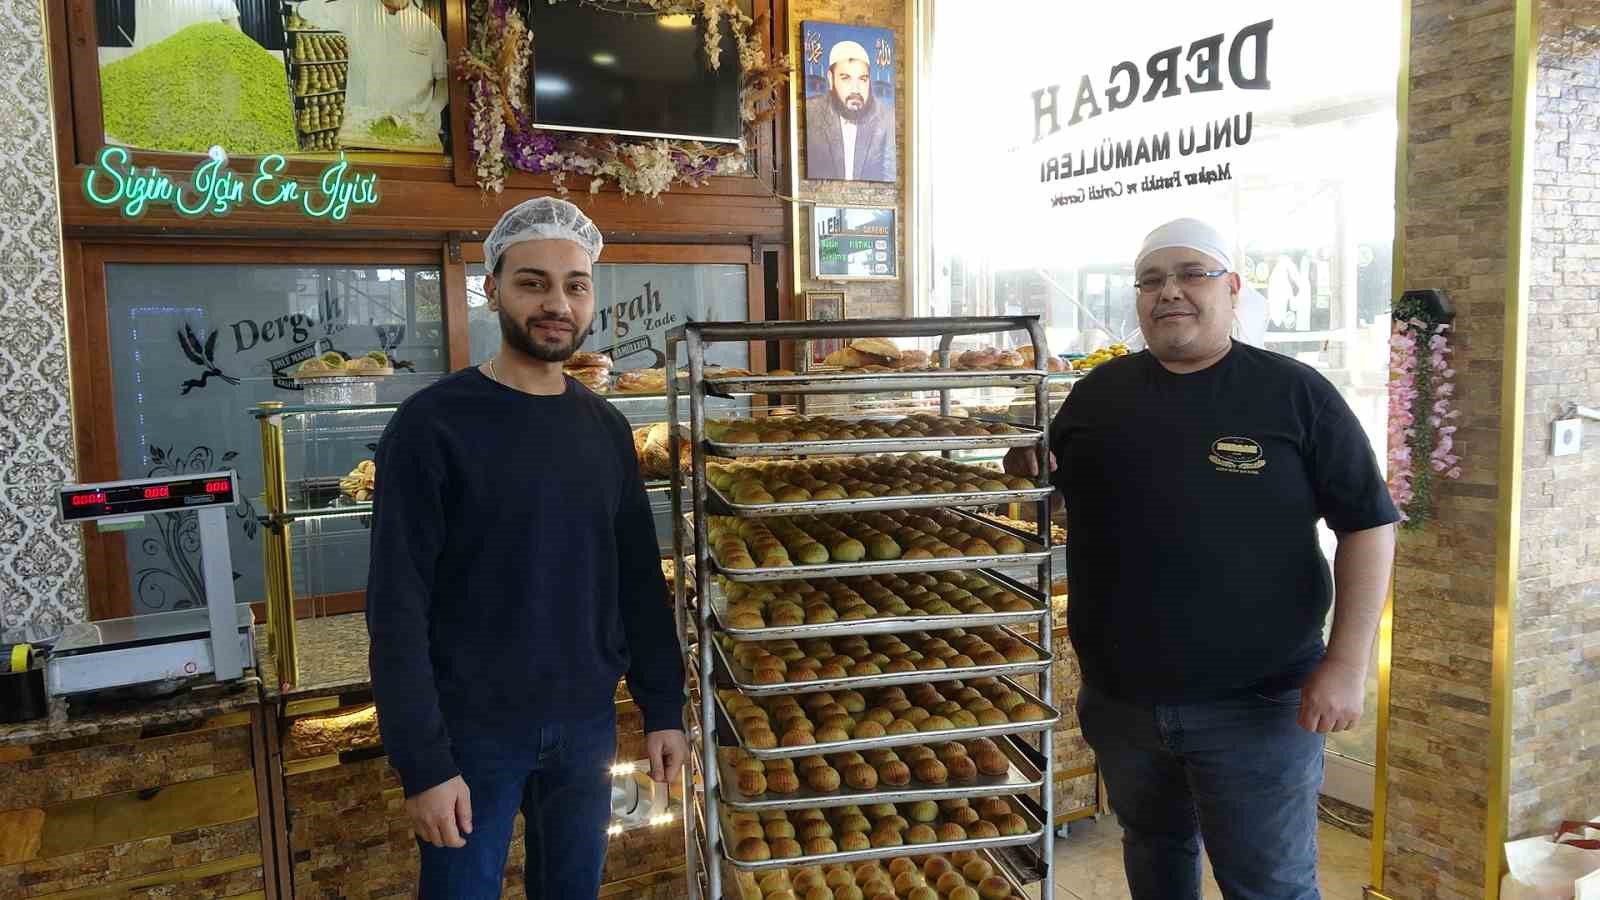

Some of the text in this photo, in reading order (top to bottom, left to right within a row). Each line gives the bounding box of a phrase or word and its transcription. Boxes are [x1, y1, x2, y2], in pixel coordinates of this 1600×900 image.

[86, 146, 174, 216] Sizin
[252, 154, 298, 205] En
[588, 281, 662, 338] rgah
[642, 311, 677, 331] Zade
